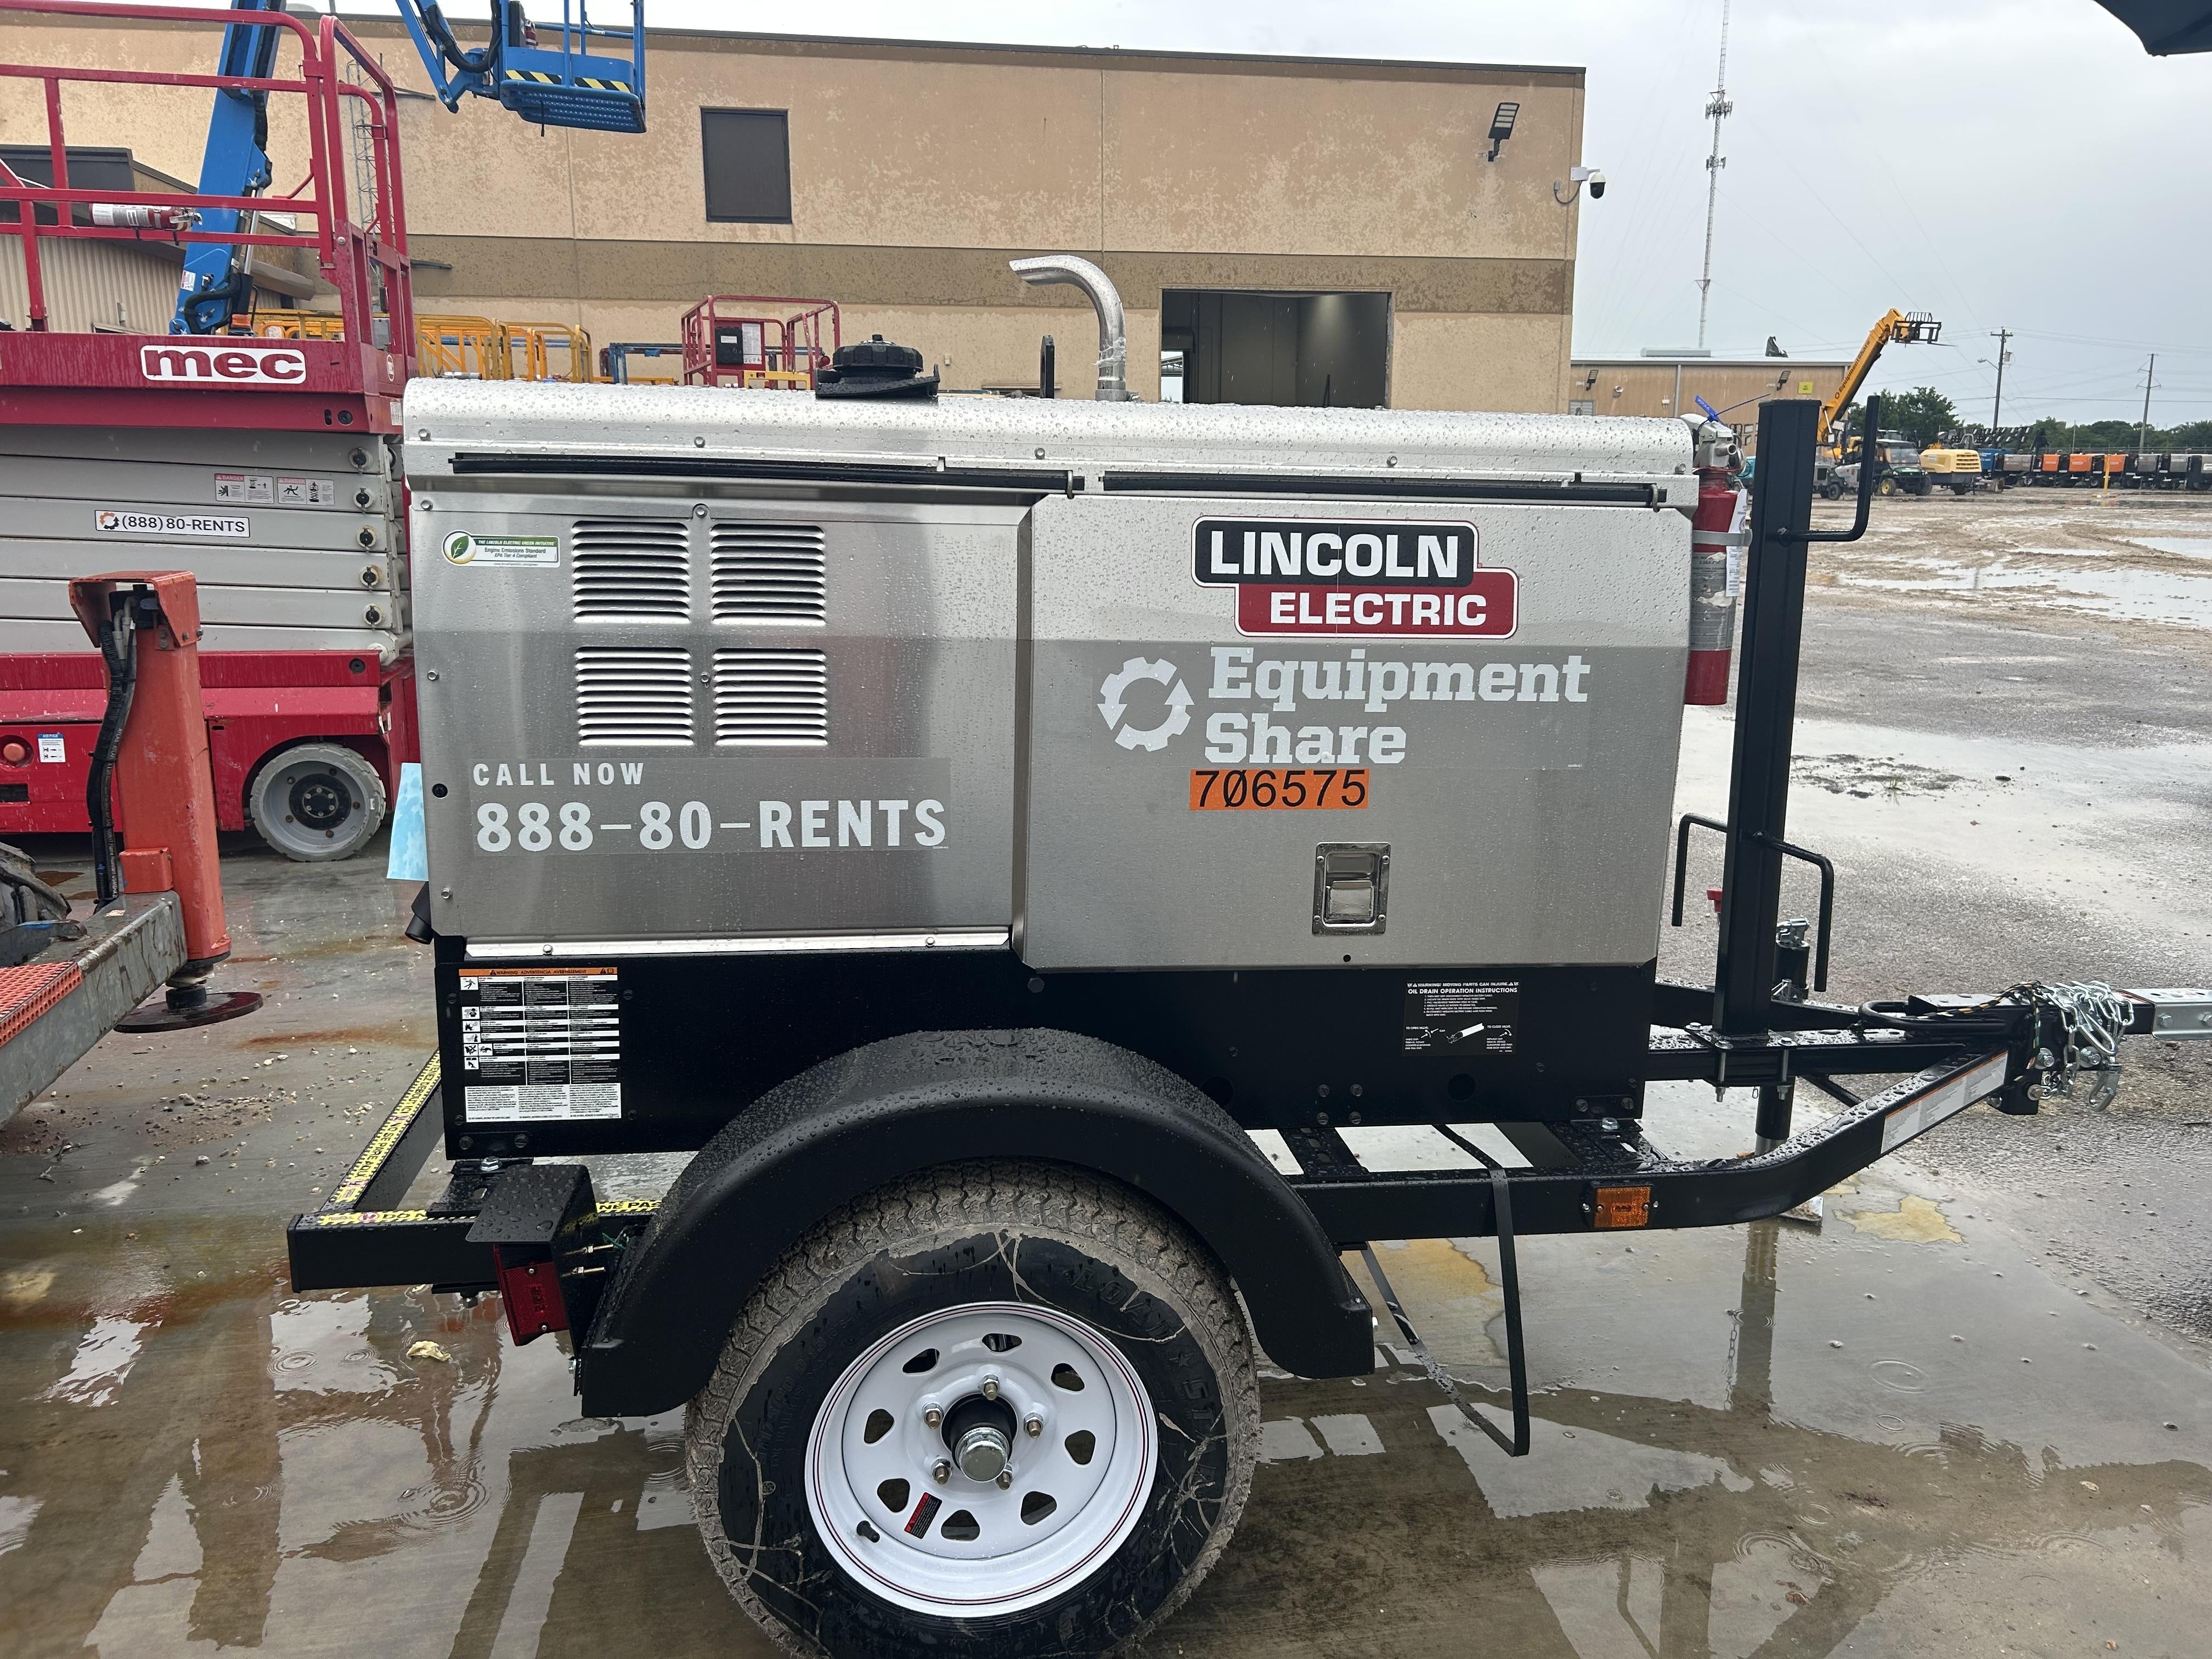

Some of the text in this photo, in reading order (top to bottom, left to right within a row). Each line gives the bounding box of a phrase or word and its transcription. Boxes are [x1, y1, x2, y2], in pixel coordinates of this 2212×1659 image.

[144, 350, 304, 379] mec
[122, 515, 245, 532] (888) 80-RENTS
[1211, 530, 1458, 578] LINCOLN
[1270, 592, 1487, 627] ELECTRIC
[1207, 646, 1590, 713] Equipment
[1205, 713, 1406, 764] Share
[473, 762, 645, 787] CALL NOW
[1194, 770, 1366, 808] 706575
[380, 1132, 394, 1141] SE
[387, 1122, 402, 1131] NO
[599, 1202, 624, 1210] NE
